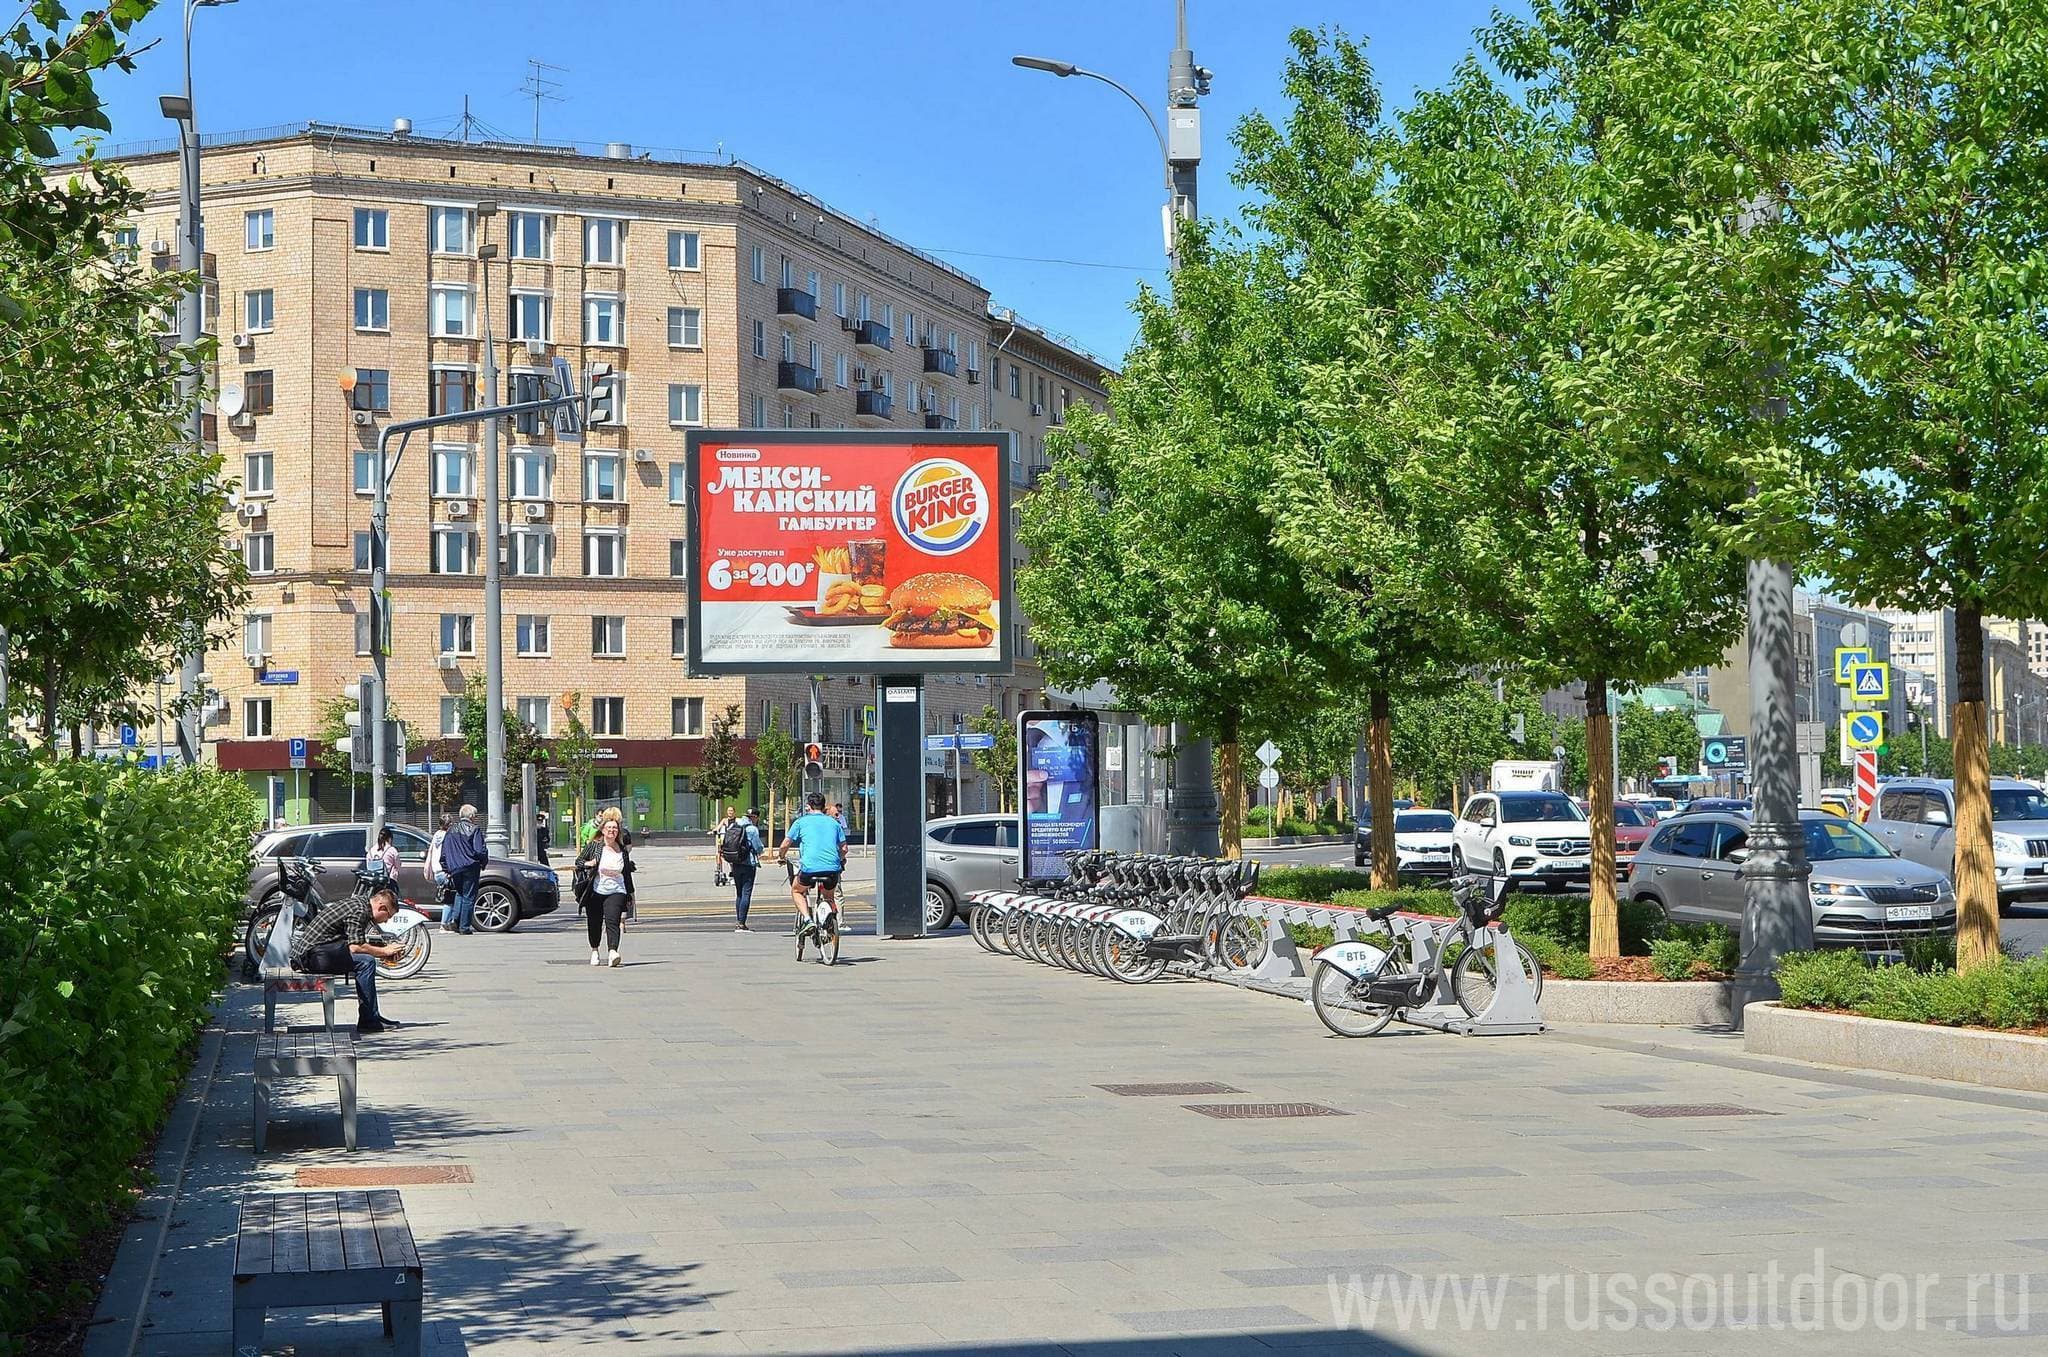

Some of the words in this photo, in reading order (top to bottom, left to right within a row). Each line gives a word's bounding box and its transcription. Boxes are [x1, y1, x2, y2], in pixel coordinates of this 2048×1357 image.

[707, 467, 831, 494] МЕКСИ-
[733, 485, 876, 513] КАНСКИЙ
[905, 477, 973, 511] BURGER
[908, 493, 977, 534] KING
[779, 517, 877, 531] ГАМБУРГЕР
[737, 549, 777, 557] доступен
[708, 559, 733, 590] 6
[733, 570, 748, 580] за
[393, 916, 409, 924] ВТБ
[1129, 916, 1146, 926] ВТБ
[1346, 950, 1366, 962] ВТБ
